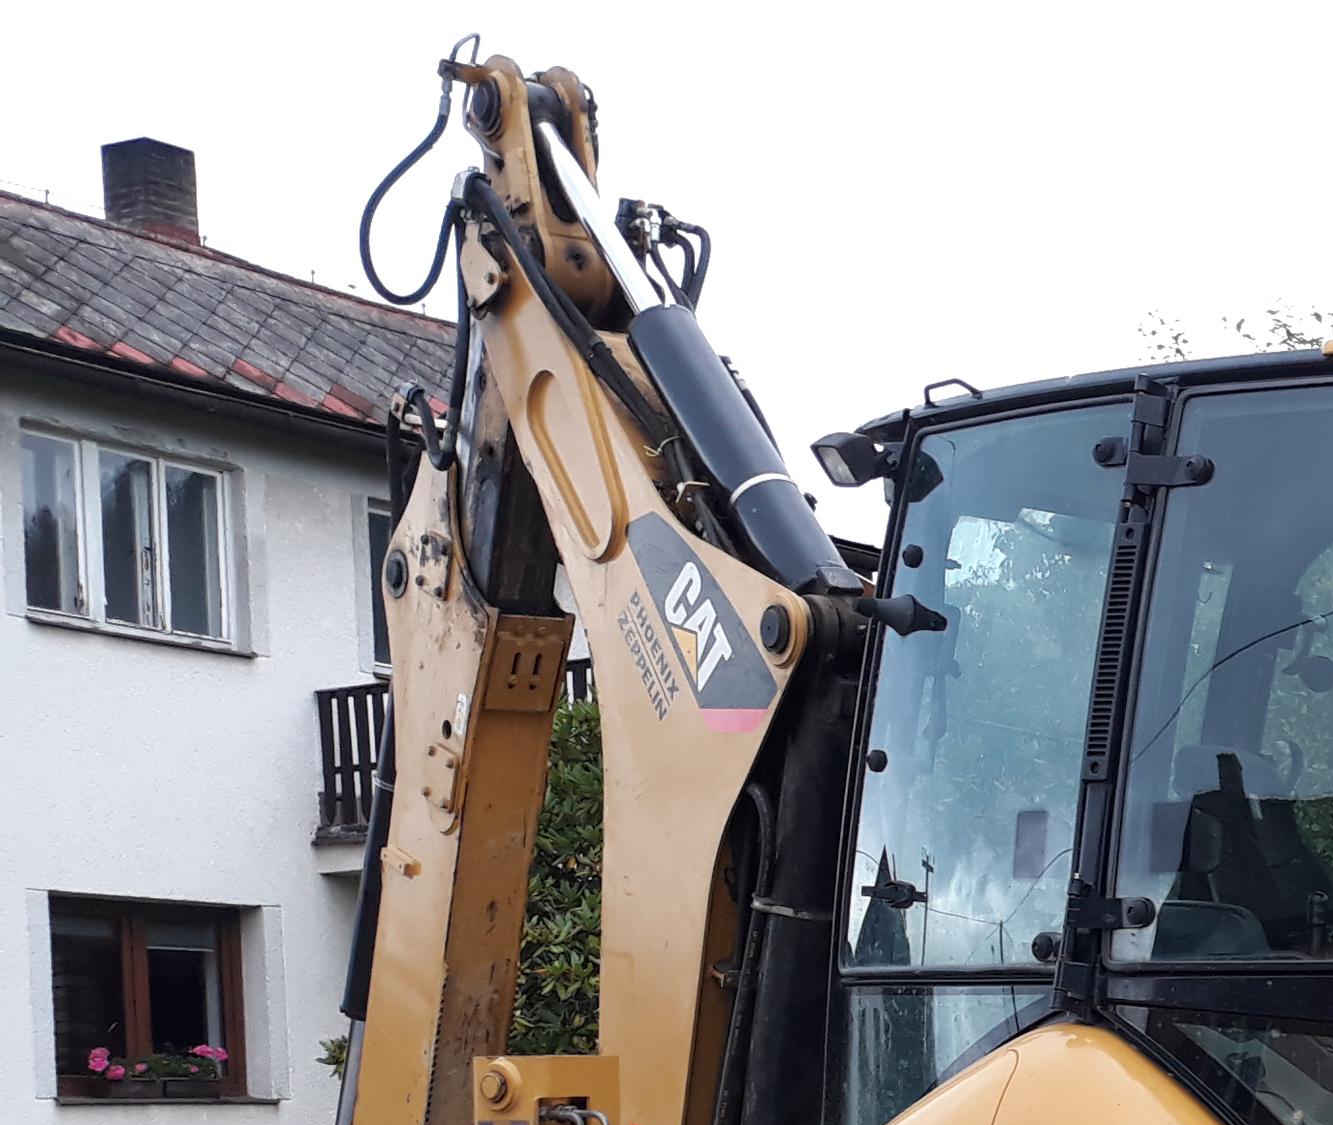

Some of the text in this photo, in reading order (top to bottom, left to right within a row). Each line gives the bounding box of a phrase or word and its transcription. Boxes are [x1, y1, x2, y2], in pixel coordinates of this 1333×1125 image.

[616, 607, 668, 721] ZEPPELIN
[628, 590, 681, 703] PHOENIX
[665, 562, 734, 693] CAT
